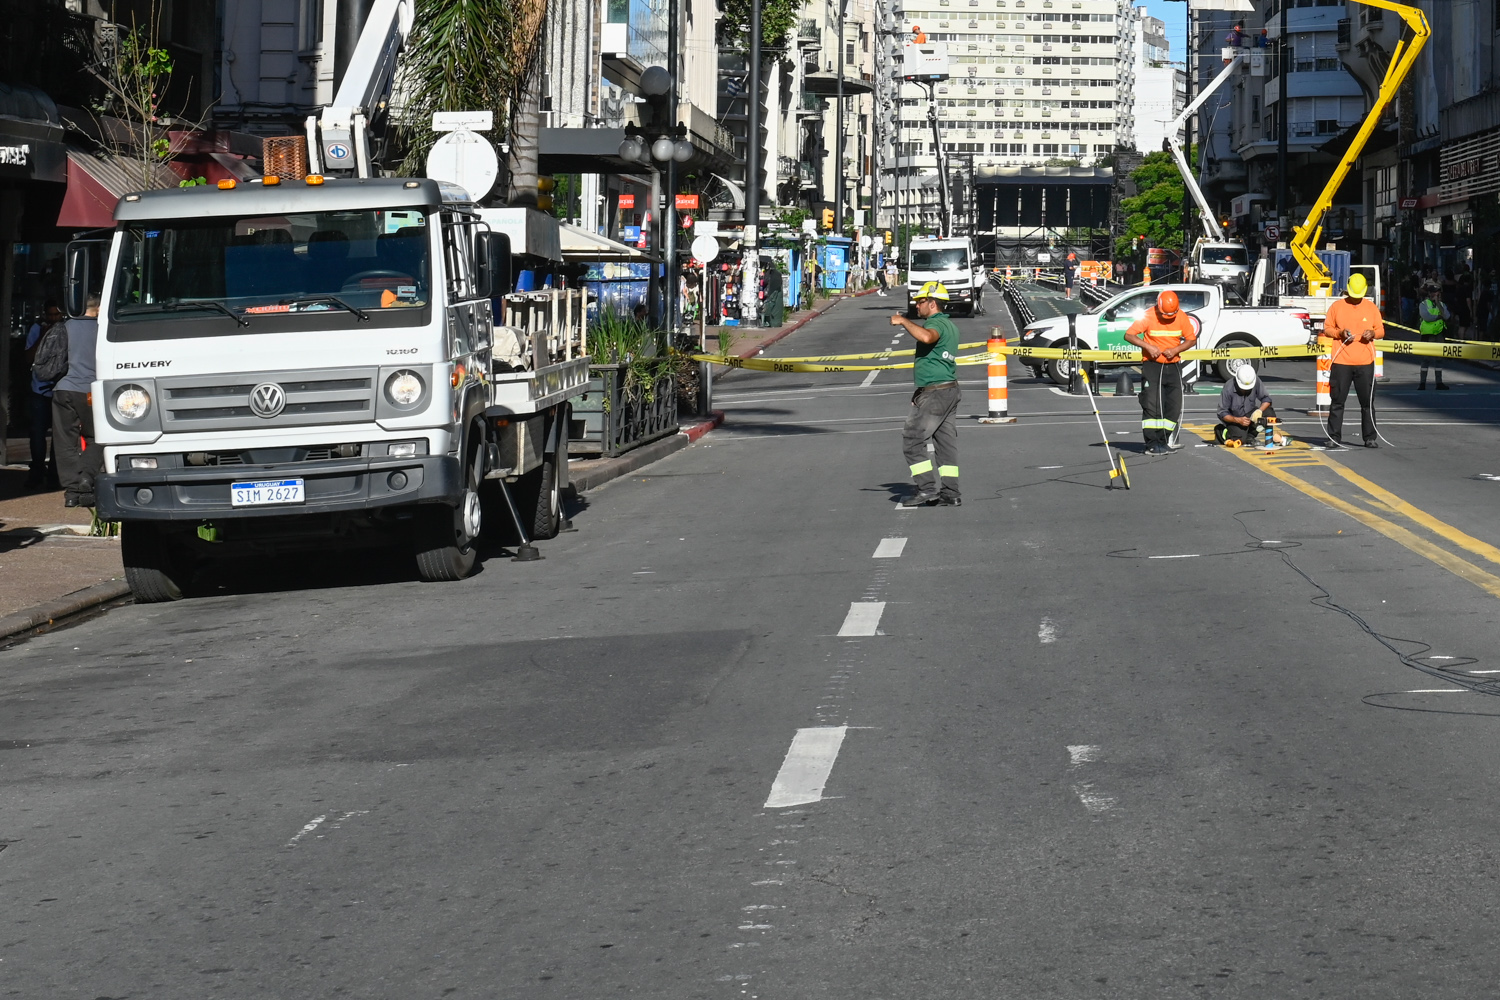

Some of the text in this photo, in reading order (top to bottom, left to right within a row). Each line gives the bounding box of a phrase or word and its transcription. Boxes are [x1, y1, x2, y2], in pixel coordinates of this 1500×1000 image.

[1062, 349, 1082, 360] PARE
[1260, 346, 1279, 356] PARE
[1307, 344, 1325, 354] PARE
[1443, 346, 1463, 357] PARE
[116, 360, 172, 370] DELIVERY
[724, 357, 744, 369] PARE
[773, 363, 794, 373] PARE
[237, 487, 299, 503] SIM 2627
